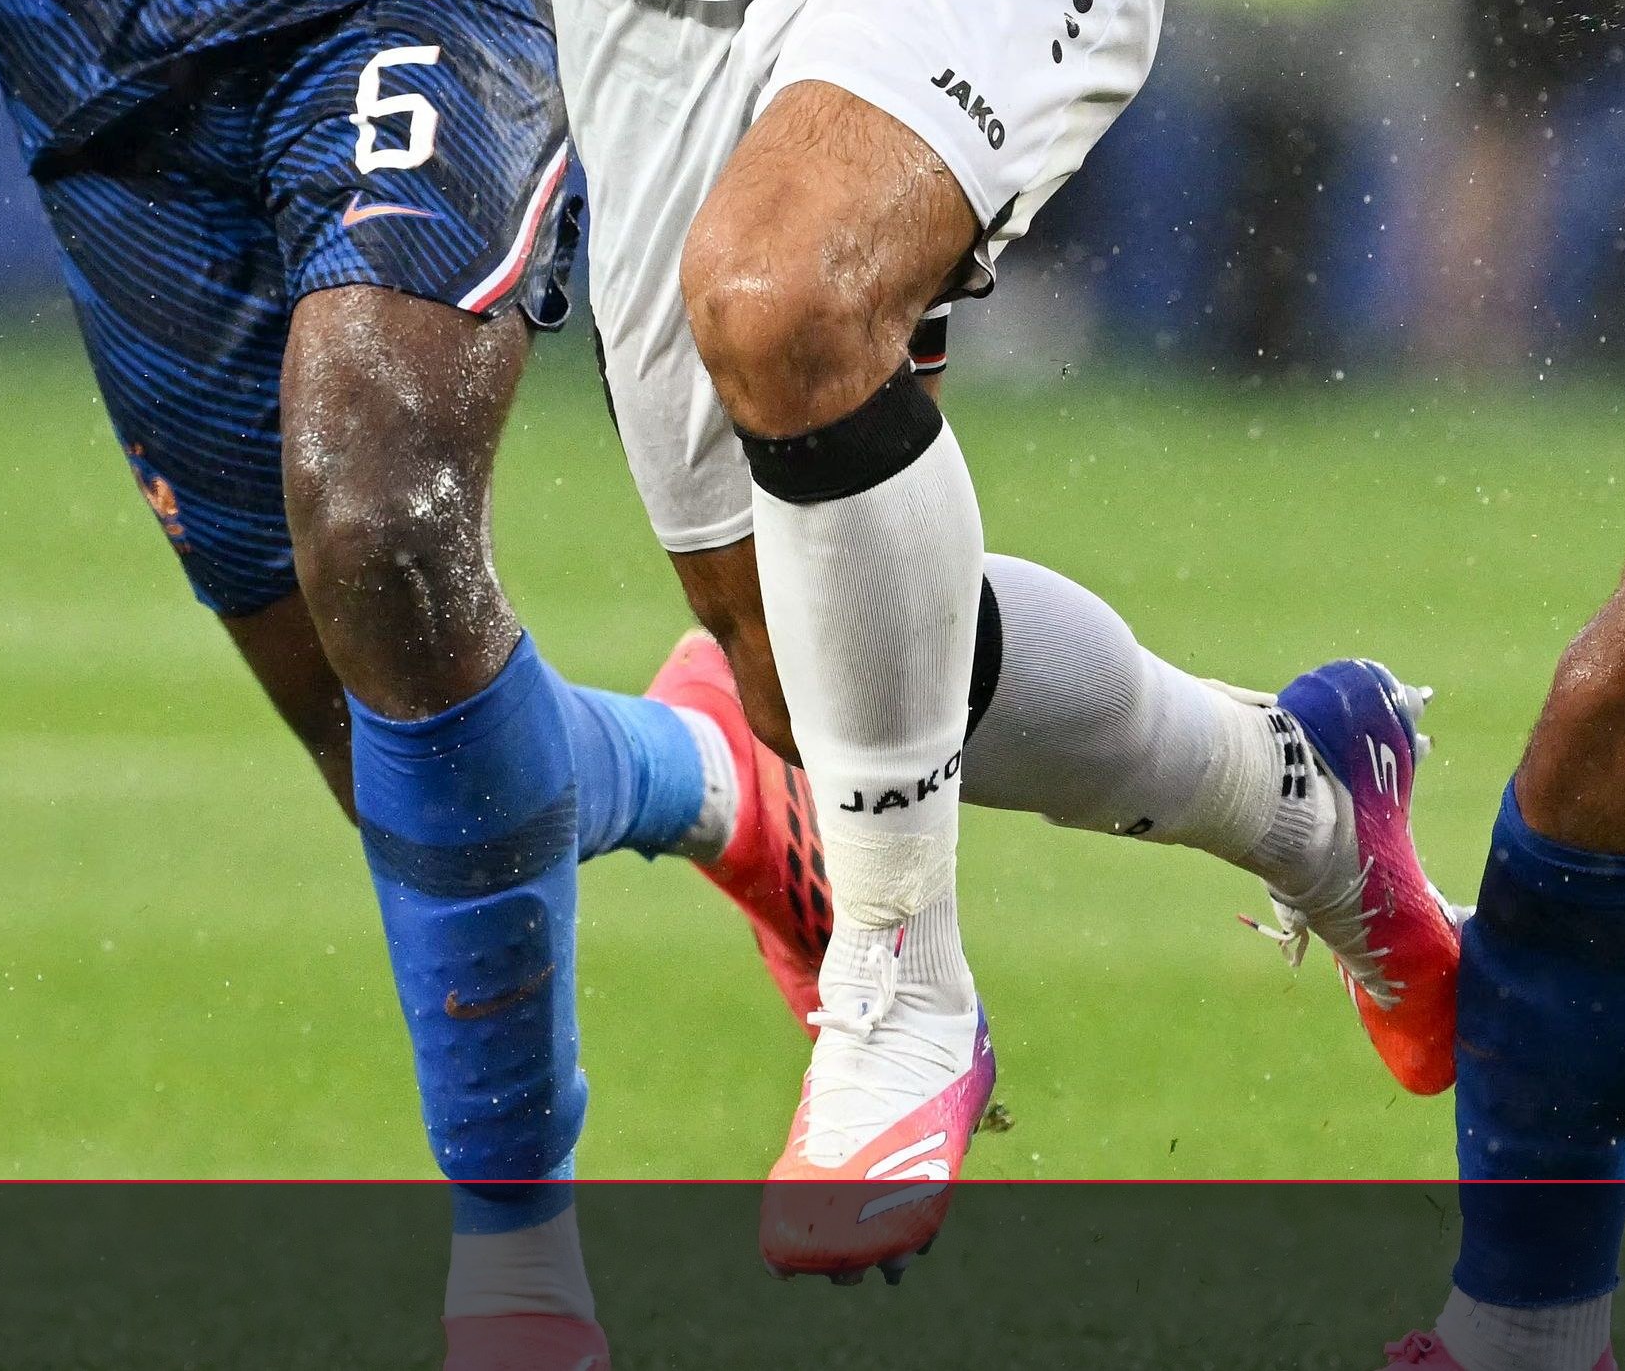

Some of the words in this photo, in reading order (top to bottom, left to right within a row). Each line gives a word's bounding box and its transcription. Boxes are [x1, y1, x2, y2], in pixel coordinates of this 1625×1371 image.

[348, 45, 440, 175] 6
[931, 68, 1005, 151] JAKO
[840, 749, 961, 814] JAKO
